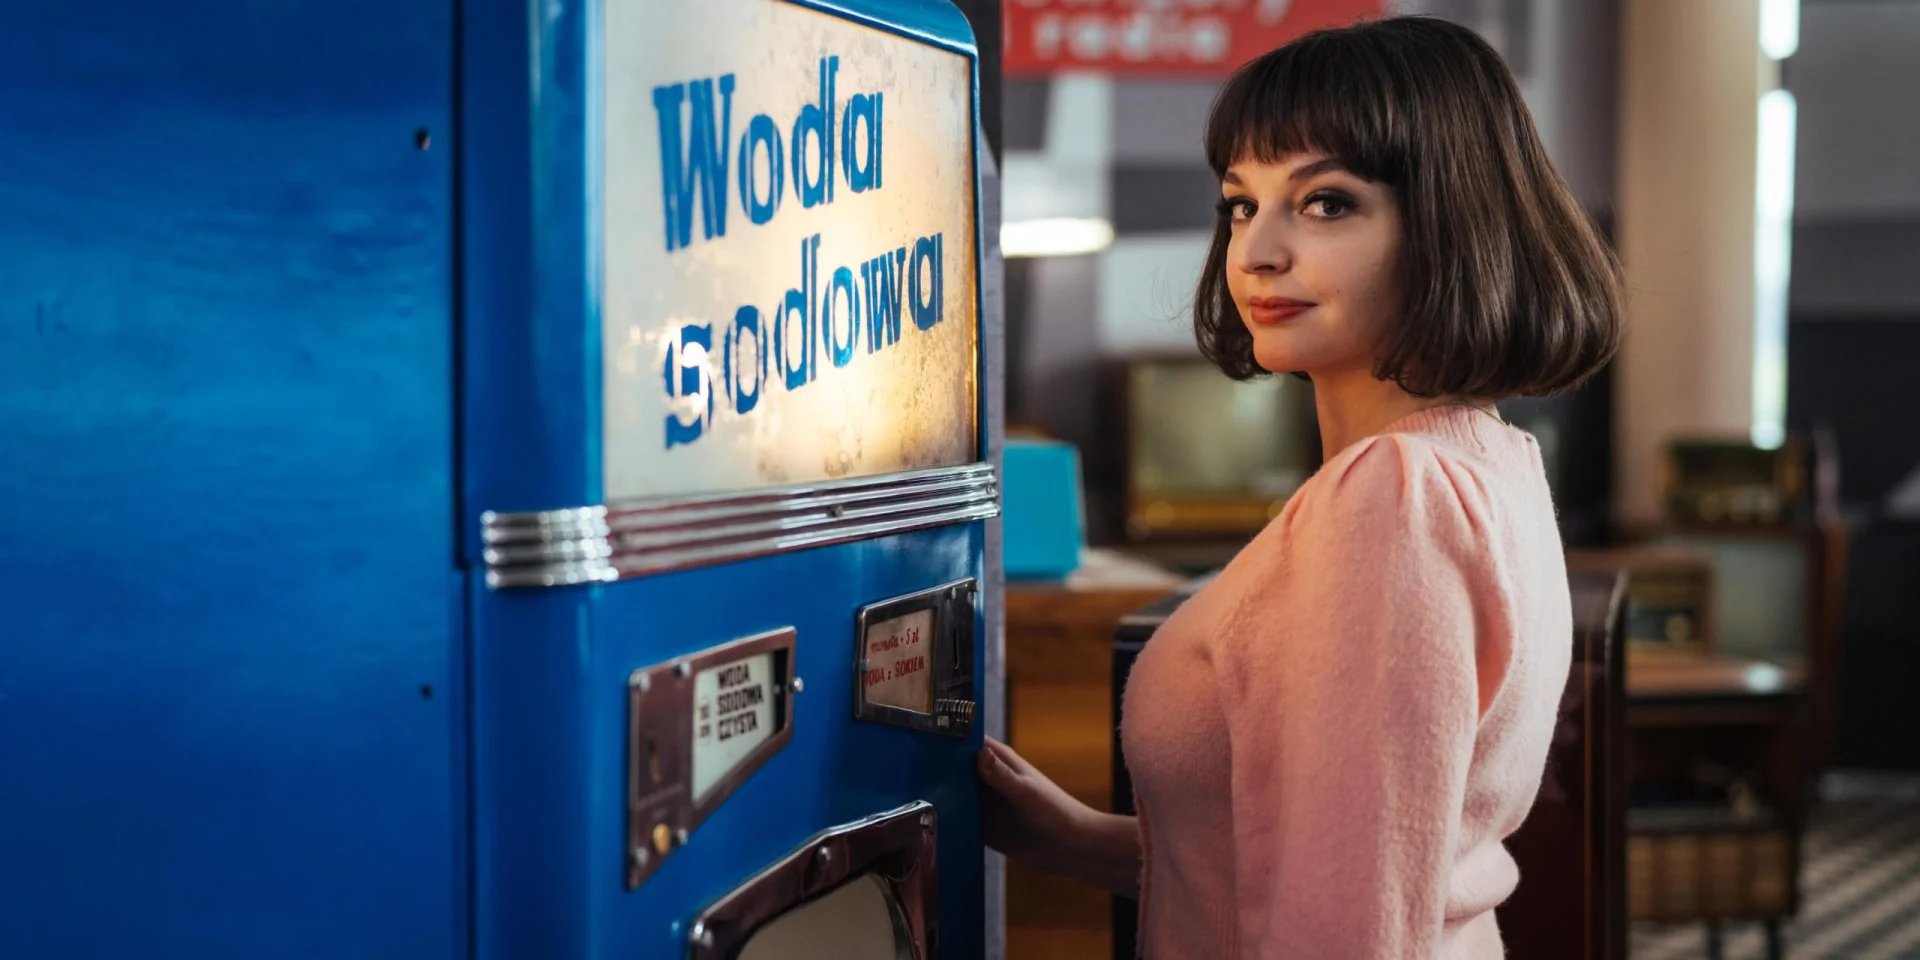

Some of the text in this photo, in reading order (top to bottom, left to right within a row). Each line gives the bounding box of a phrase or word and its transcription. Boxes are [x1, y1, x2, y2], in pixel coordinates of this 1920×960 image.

[651, 55, 883, 253] Woda
[662, 233, 944, 449] sodowa
[717, 663, 752, 689] WODA
[894, 655, 925, 677] SOKIEM
[717, 684, 765, 716] SODOWA
[717, 711, 759, 742] CZYSTA
